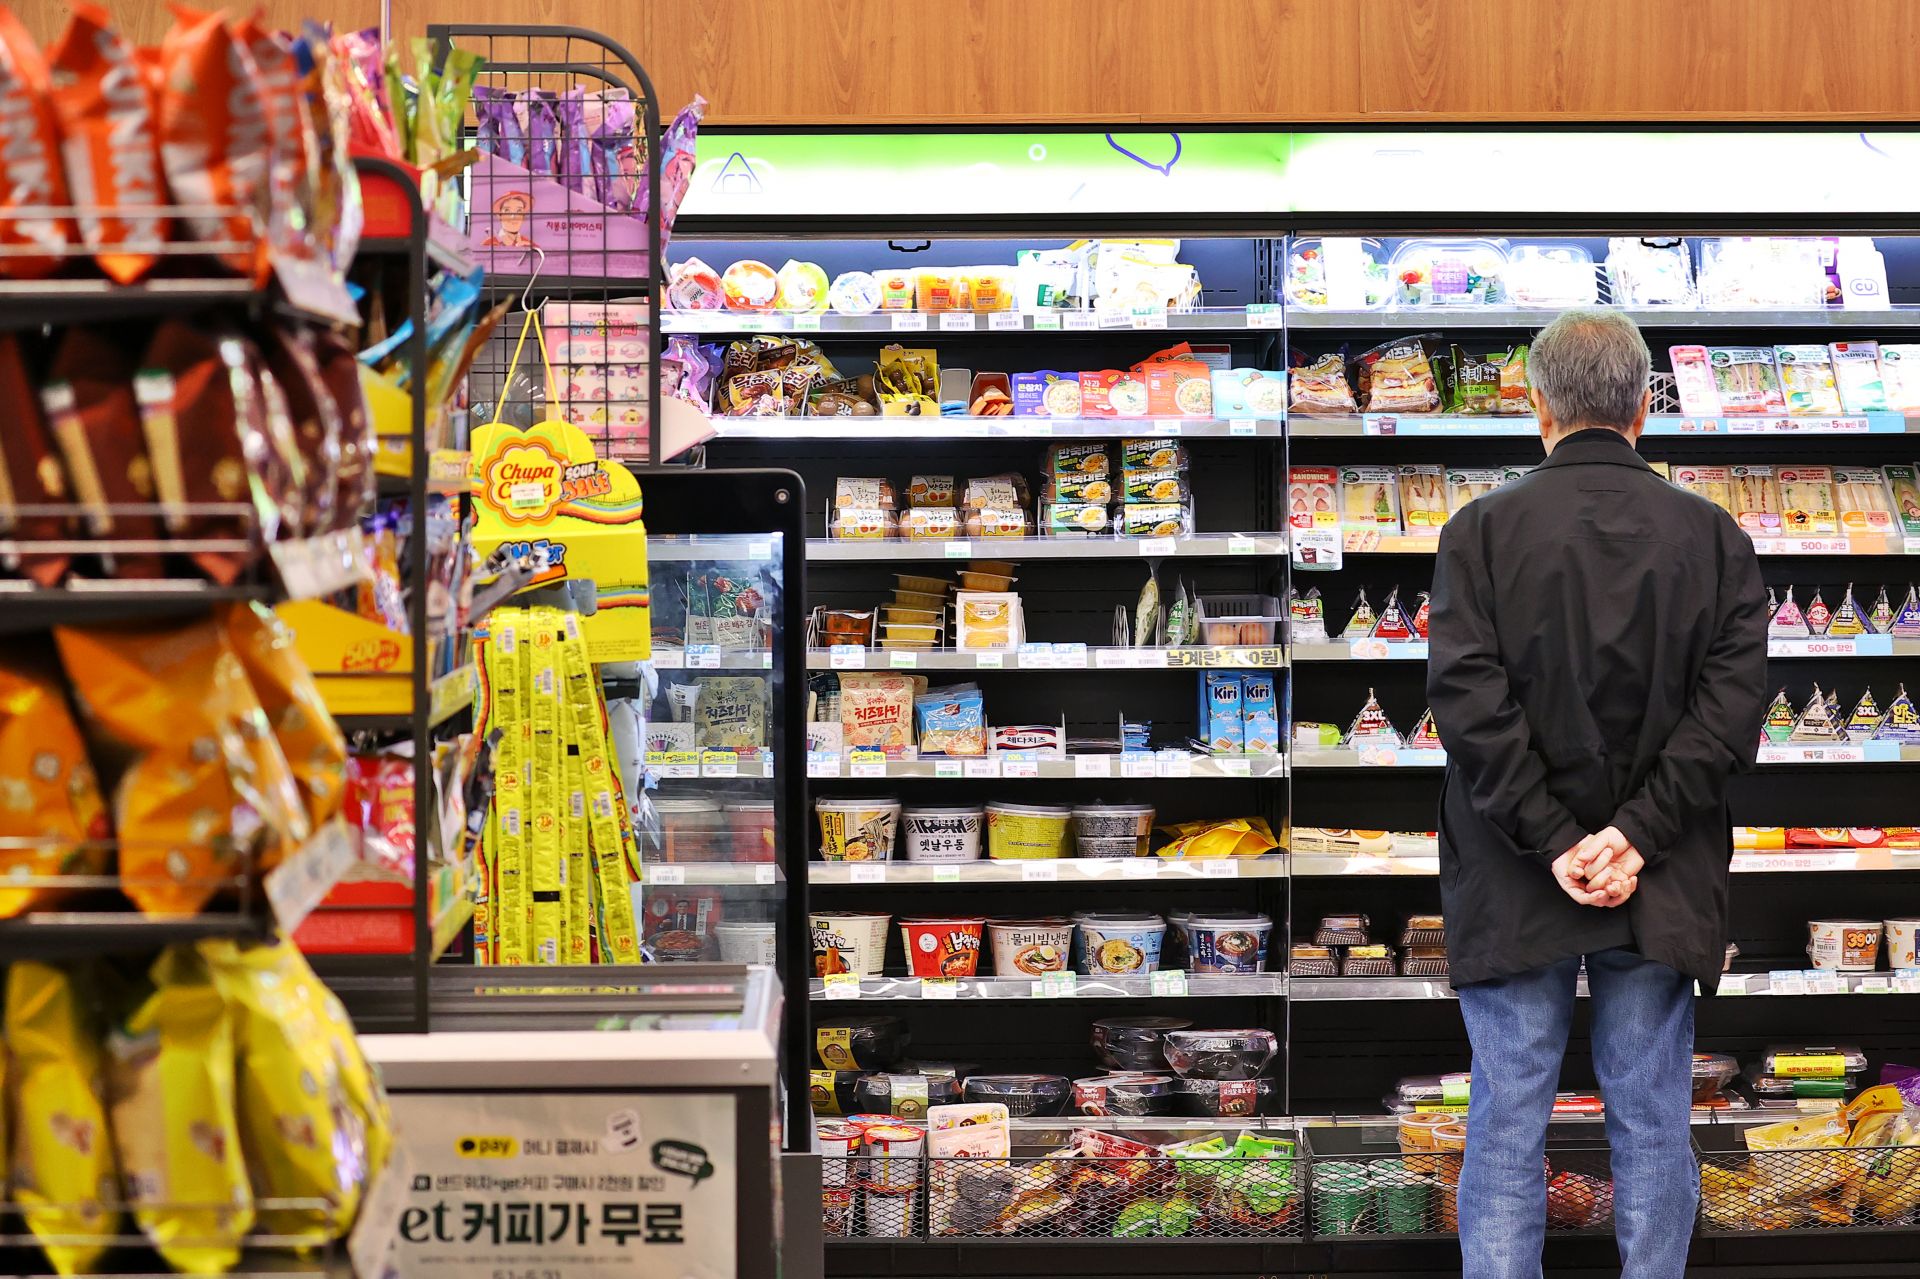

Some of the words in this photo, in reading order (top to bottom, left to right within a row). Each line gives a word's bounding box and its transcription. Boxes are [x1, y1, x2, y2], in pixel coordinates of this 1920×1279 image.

[1855, 282, 1873, 290] CU
[500, 463, 554, 482] Chupa
[565, 463, 597, 480] SOUR
[1167, 651, 1221, 666] 날계란
[1214, 687, 1237, 700] Kiri
[1246, 685, 1270, 699] Kiri
[855, 705, 900, 720] 치즈파티
[1363, 711, 1385, 720] 3XL
[1776, 711, 1791, 719] 3XL
[1858, 707, 1877, 716] 3XL
[1007, 736, 1047, 745] 체다치즈
[920, 839, 964, 851] 옛날우동
[1011, 932, 1068, 945] 물비빔냉면
[1847, 931, 1877, 948] 3900
[480, 1139, 512, 1154] pay
[637, 1175, 666, 1191] 할인
[399, 1200, 590, 1245] et커피가
[601, 1203, 684, 1245] 무료
